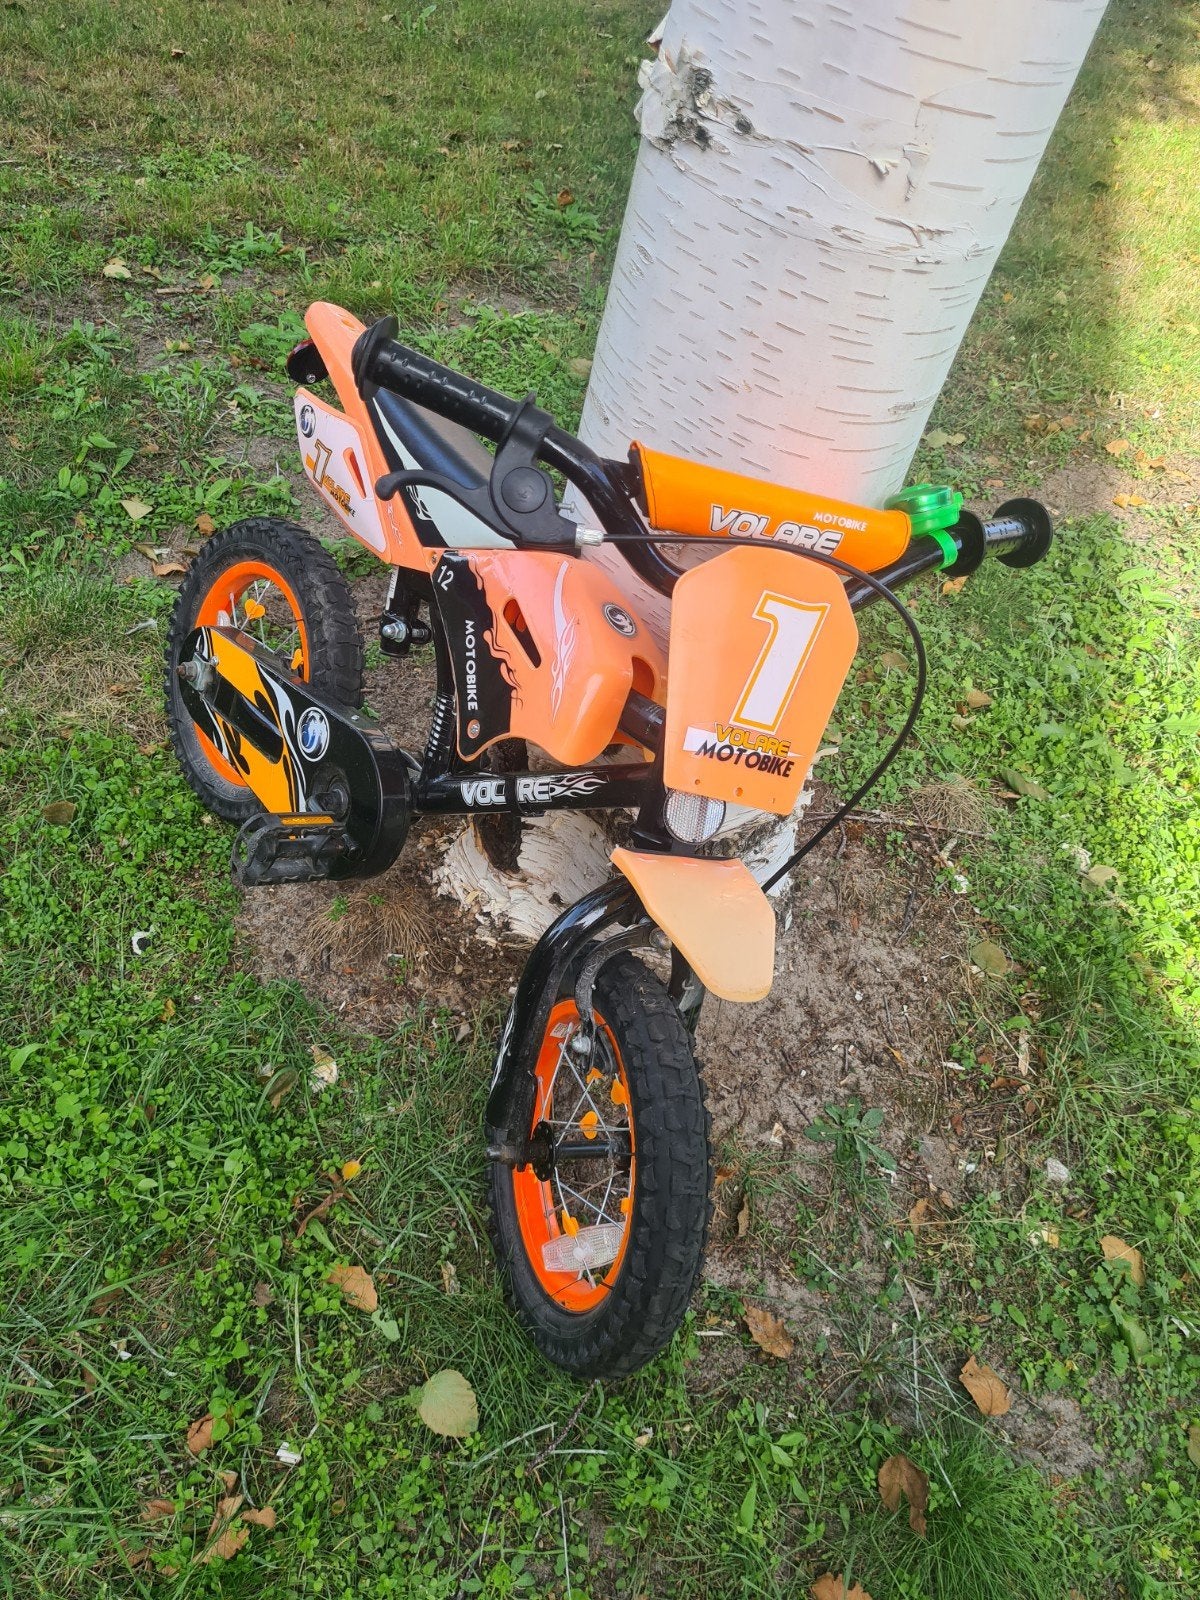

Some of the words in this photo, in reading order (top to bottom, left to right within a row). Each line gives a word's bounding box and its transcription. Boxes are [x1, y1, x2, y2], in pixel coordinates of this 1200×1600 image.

[710, 504, 844, 558] VOLARE
[813, 512, 868, 532] MOTOBIKE
[437, 565, 454, 591] 12
[465, 619, 478, 711] MOTOBIKE
[728, 590, 831, 735] 1
[715, 723, 791, 758] VOLARE
[695, 740, 795, 778] MOTOBIKE
[460, 778, 552, 807] VOLRE
